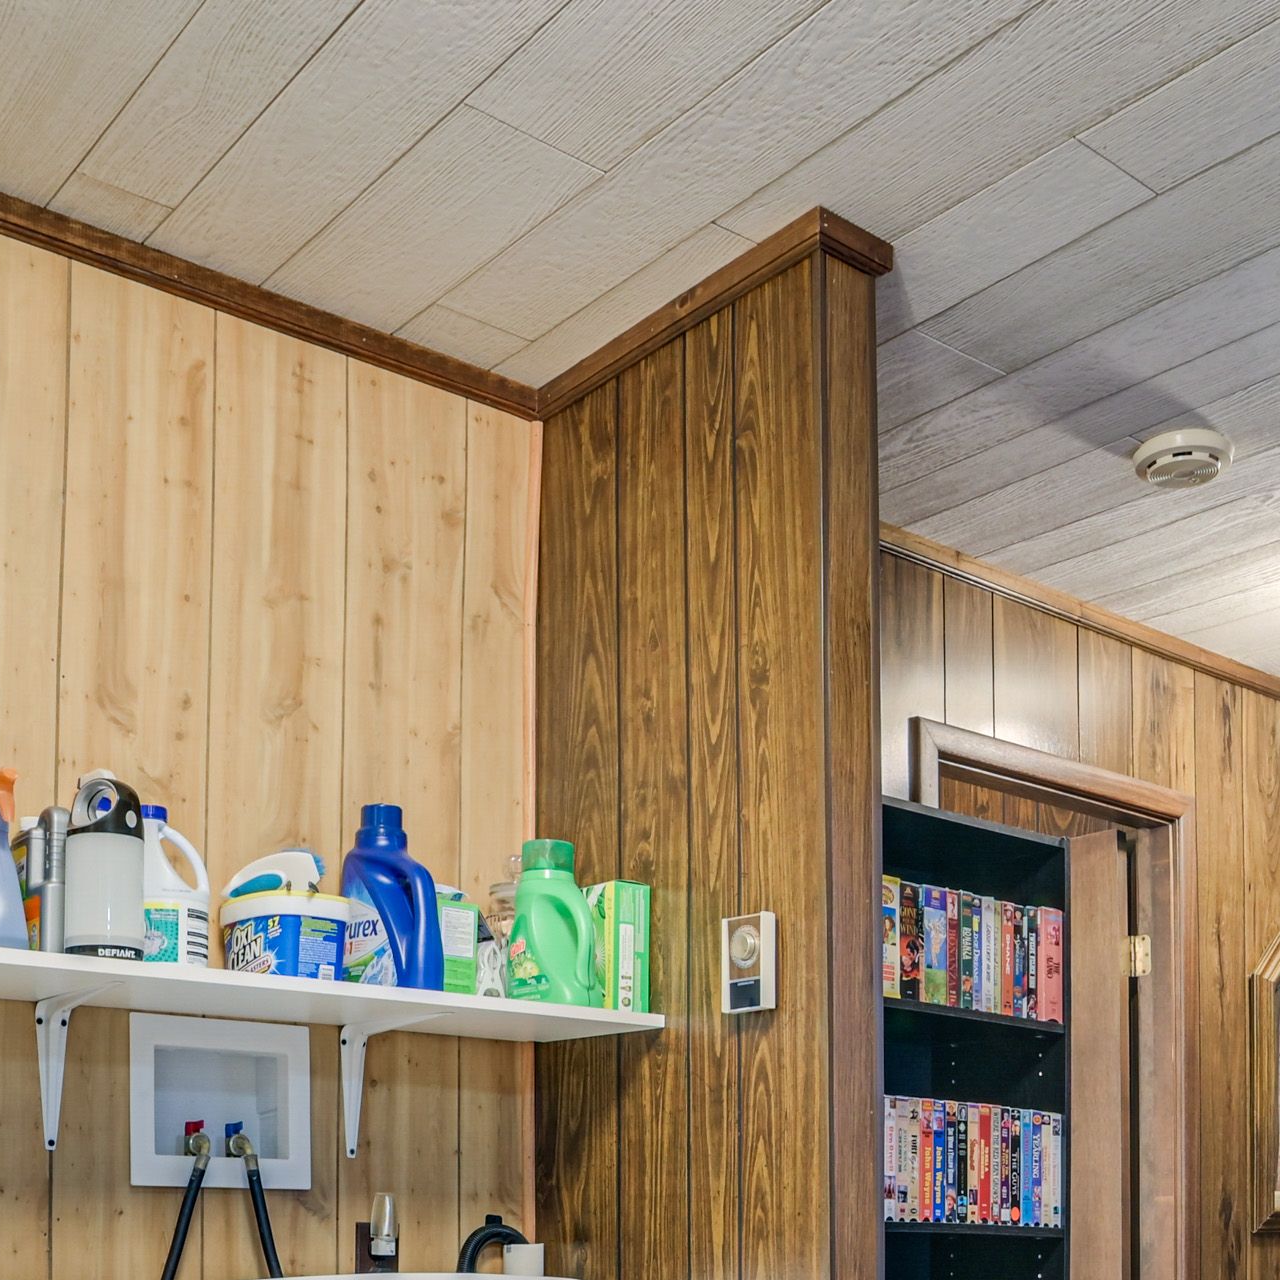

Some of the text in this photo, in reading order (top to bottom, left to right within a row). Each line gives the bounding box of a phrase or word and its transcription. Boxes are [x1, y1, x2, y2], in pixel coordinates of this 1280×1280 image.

[97, 948, 136, 959] DEFIANT
[232, 924, 254, 949] OXI
[923, 1146, 932, 1205] John Wayne
[934, 1145, 943, 1204] John Wayne
